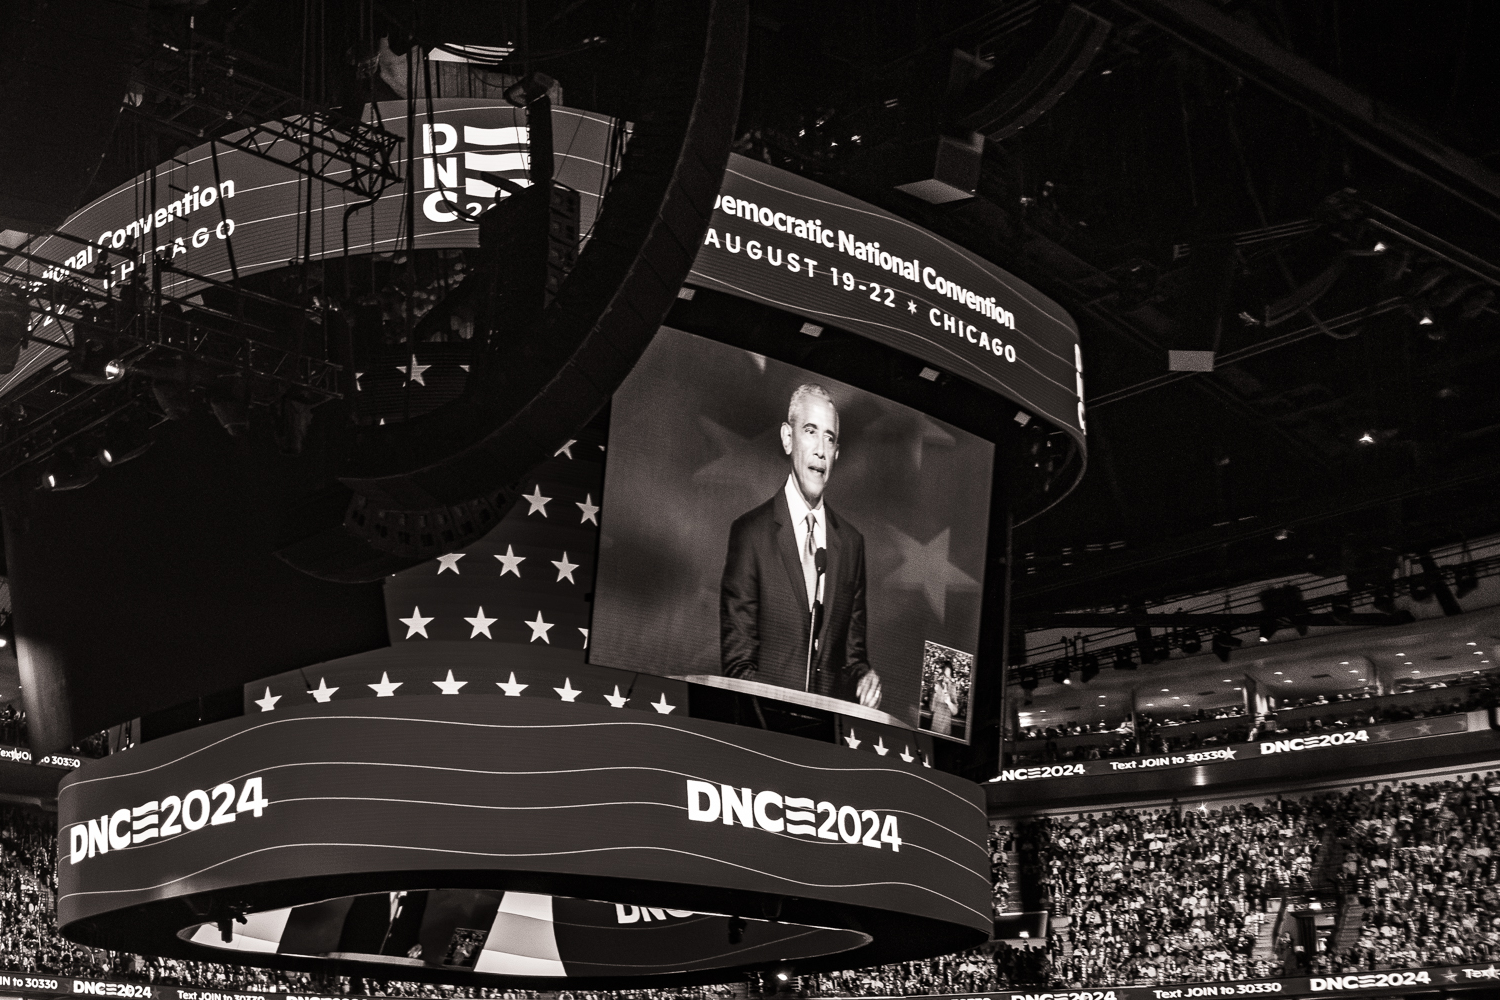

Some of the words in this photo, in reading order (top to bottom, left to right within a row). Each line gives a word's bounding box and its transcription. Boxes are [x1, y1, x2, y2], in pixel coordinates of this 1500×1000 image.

[704, 228, 818, 278] AUGUST
[830, 268, 896, 308] 19-22
[929, 308, 1016, 363] CHICAGO
[838, 230, 920, 282] National
[923, 268, 1015, 329] Convention
[13, 978, 23, 987] to
[25, 978, 57, 989] 30330
[1153, 990, 1182, 999] Text
[1184, 987, 1217, 997] JOIN
[1237, 983, 1281, 994] 30330
